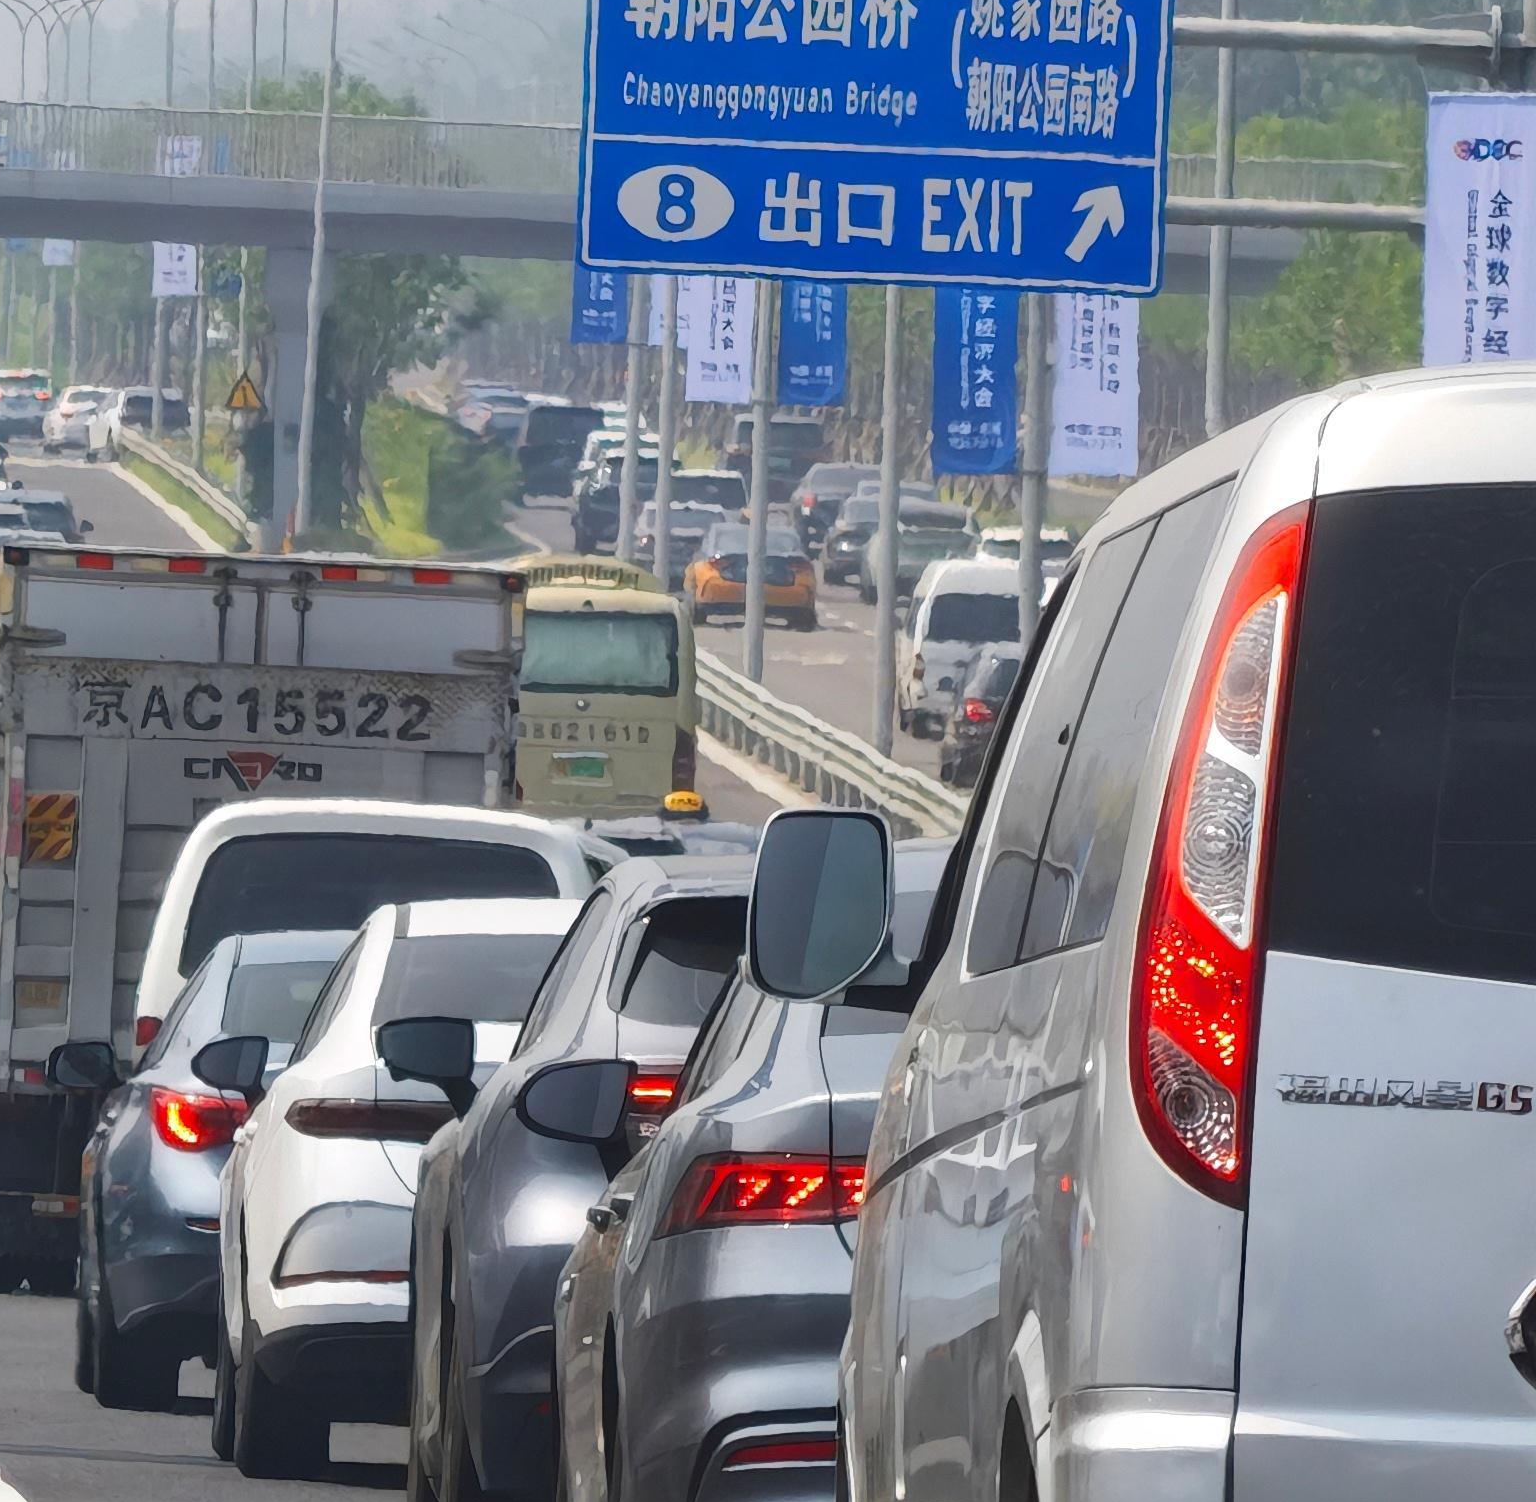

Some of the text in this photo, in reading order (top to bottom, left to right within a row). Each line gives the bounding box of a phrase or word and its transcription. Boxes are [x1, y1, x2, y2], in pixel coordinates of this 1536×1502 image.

[623, 72, 918, 127] Chaoyanggongyuan Bridge
[656, 172, 1034, 256] 8 出口 EXIT
[81, 681, 434, 741] 京AC15522
